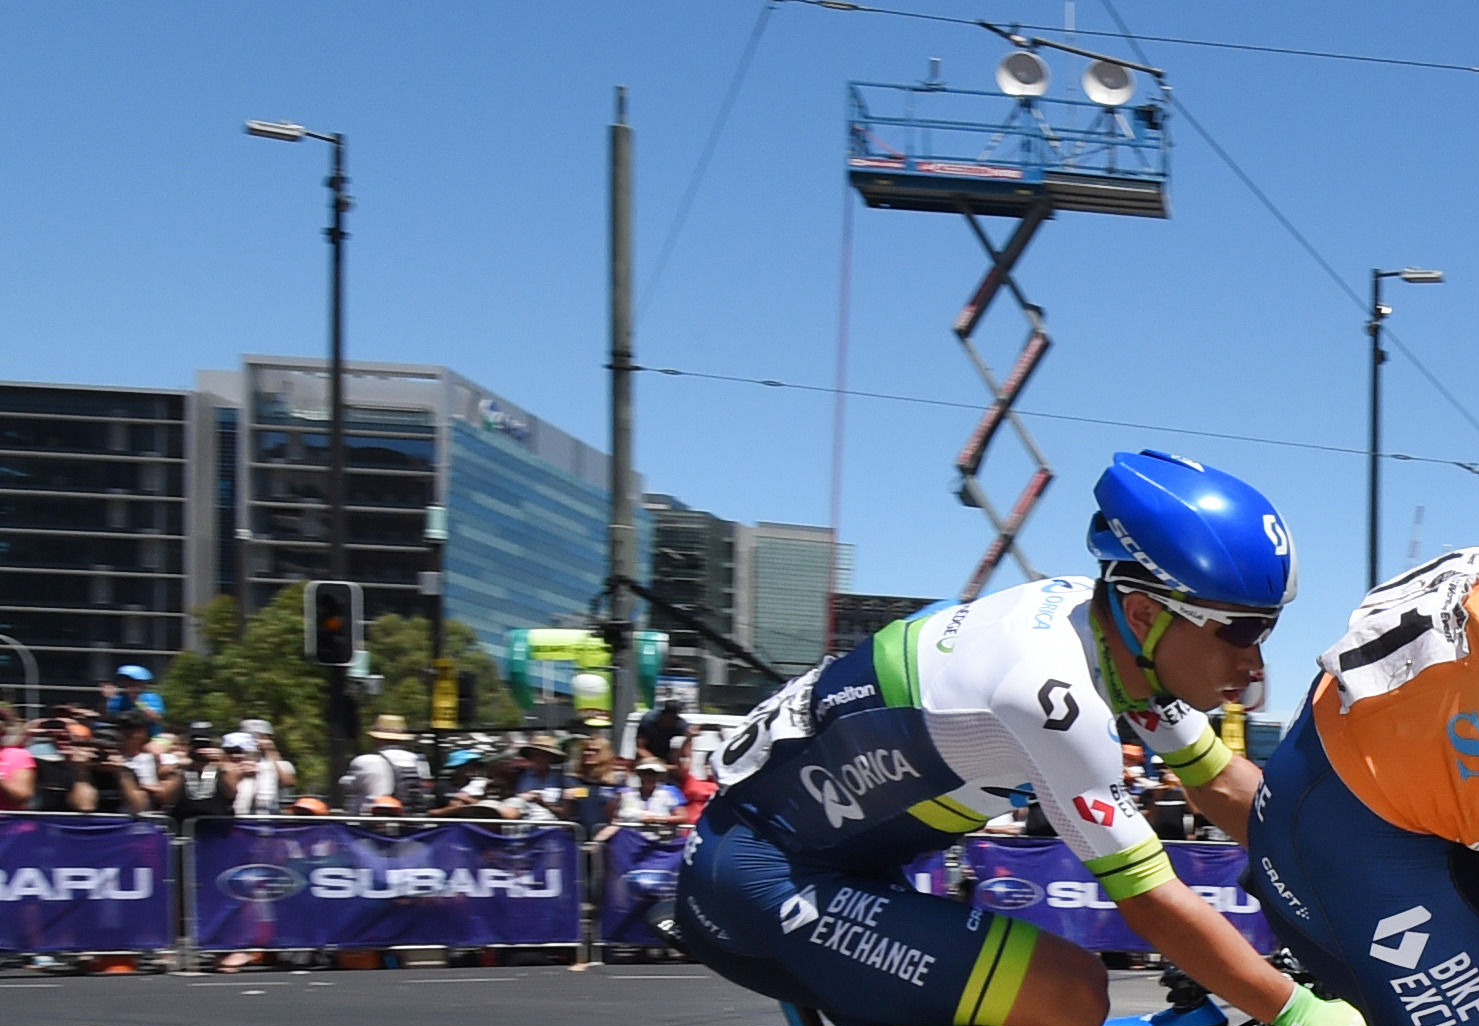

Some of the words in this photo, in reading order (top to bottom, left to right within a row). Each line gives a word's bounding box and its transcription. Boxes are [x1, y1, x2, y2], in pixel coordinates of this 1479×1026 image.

[1107, 518, 1197, 595] SCOTT
[1032, 595, 1064, 630] ORICA
[840, 748, 921, 797] ORICA
[310, 867, 562, 898] SUBARU
[1261, 857, 1301, 907] CRAFT
[828, 886, 889, 928] BIKE
[809, 916, 936, 987] EXCHANGE
